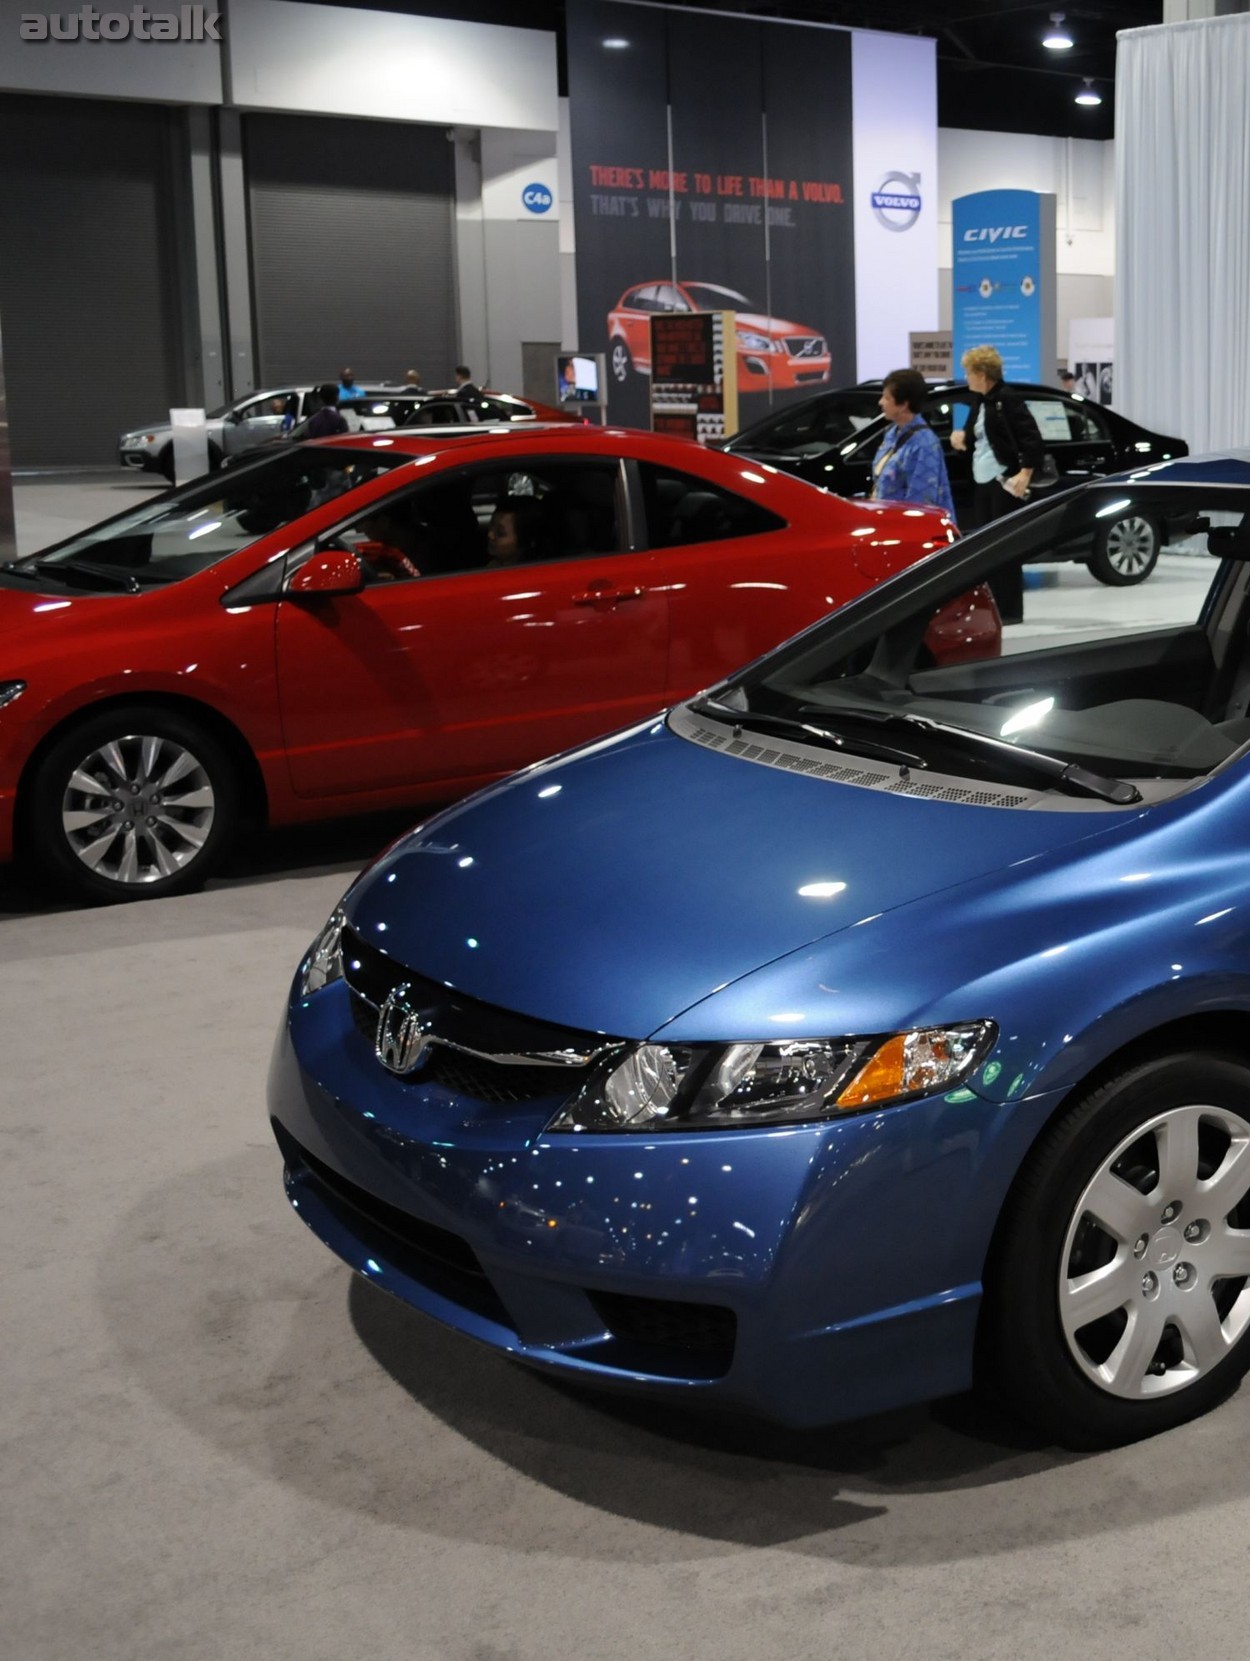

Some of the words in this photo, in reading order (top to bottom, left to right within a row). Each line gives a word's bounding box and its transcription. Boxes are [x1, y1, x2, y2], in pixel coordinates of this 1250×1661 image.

[589, 165, 645, 190] THERE'S
[648, 169, 689, 193] MORE
[694, 172, 712, 195] TO
[716, 175, 743, 197] LIFE
[748, 176, 785, 200] THAN
[788, 179, 799, 201] A
[802, 181, 845, 204] VOLVO.
[524, 191, 551, 206] C4a
[873, 195, 921, 209] VOLVO
[589, 193, 640, 217] THAT'S
[645, 197, 682, 220] WHY
[689, 201, 717, 223] YOU
[723, 203, 762, 225] DRIVE
[766, 205, 797, 228] ONE.
[963, 225, 1029, 244] CIVIC
